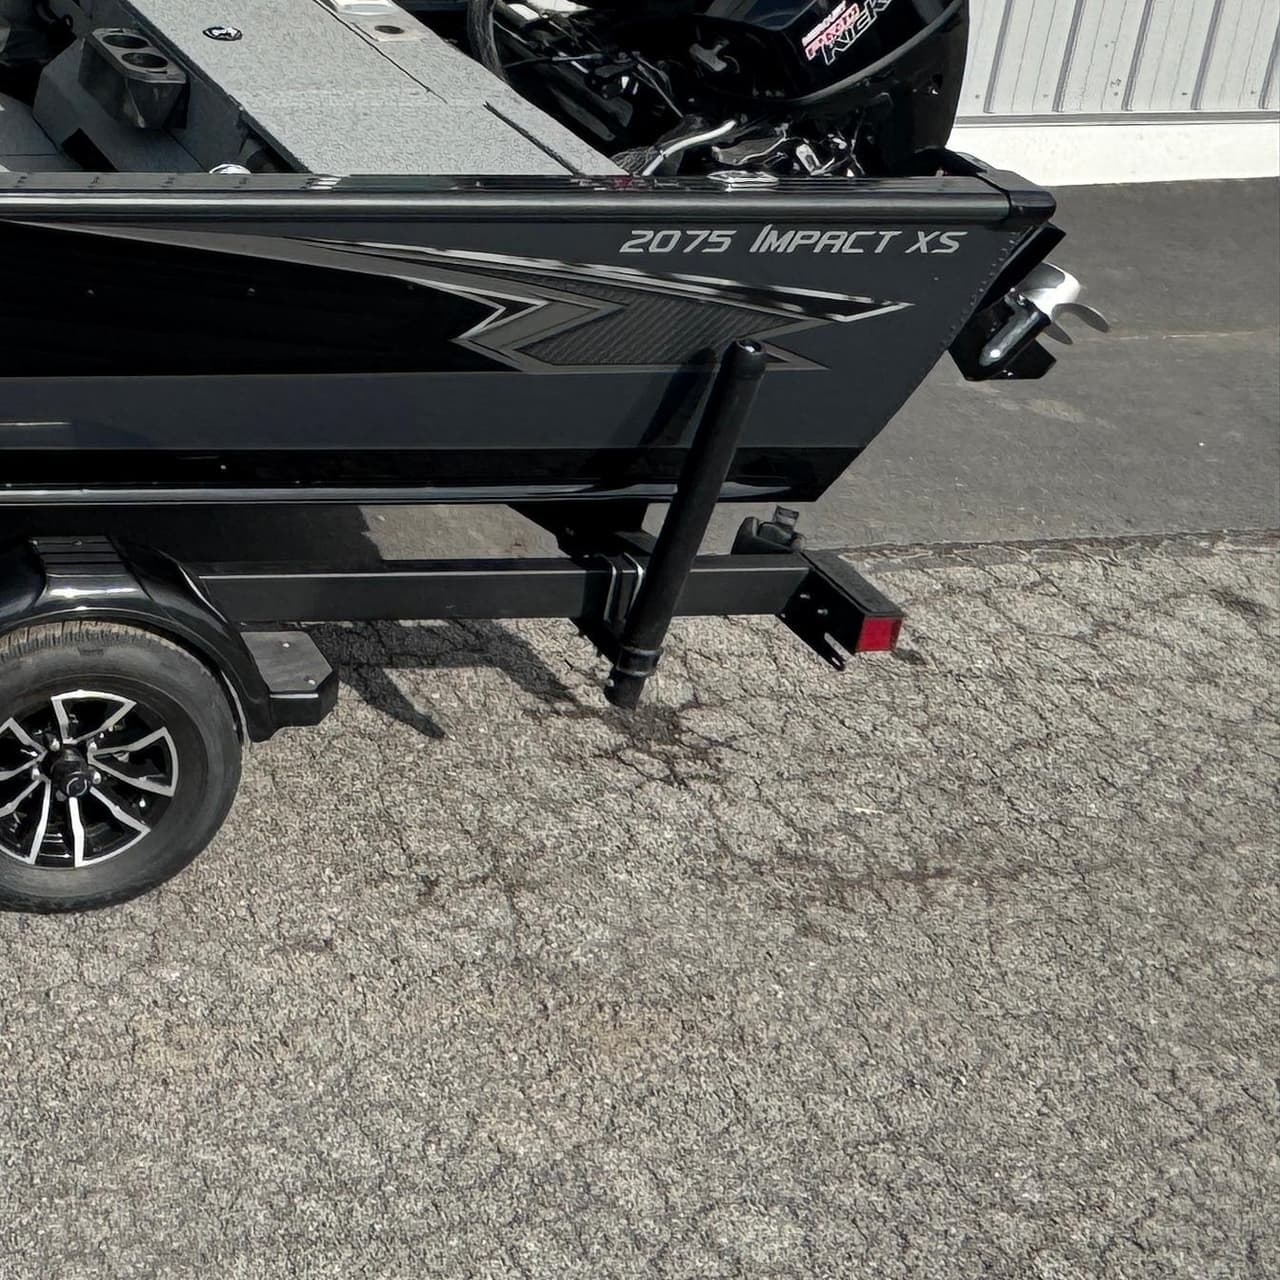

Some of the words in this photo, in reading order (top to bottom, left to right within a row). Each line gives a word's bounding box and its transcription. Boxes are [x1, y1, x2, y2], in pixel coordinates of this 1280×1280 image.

[618, 229, 738, 253] 2075
[748, 223, 903, 254] IMPACT
[904, 231, 968, 255] XS
